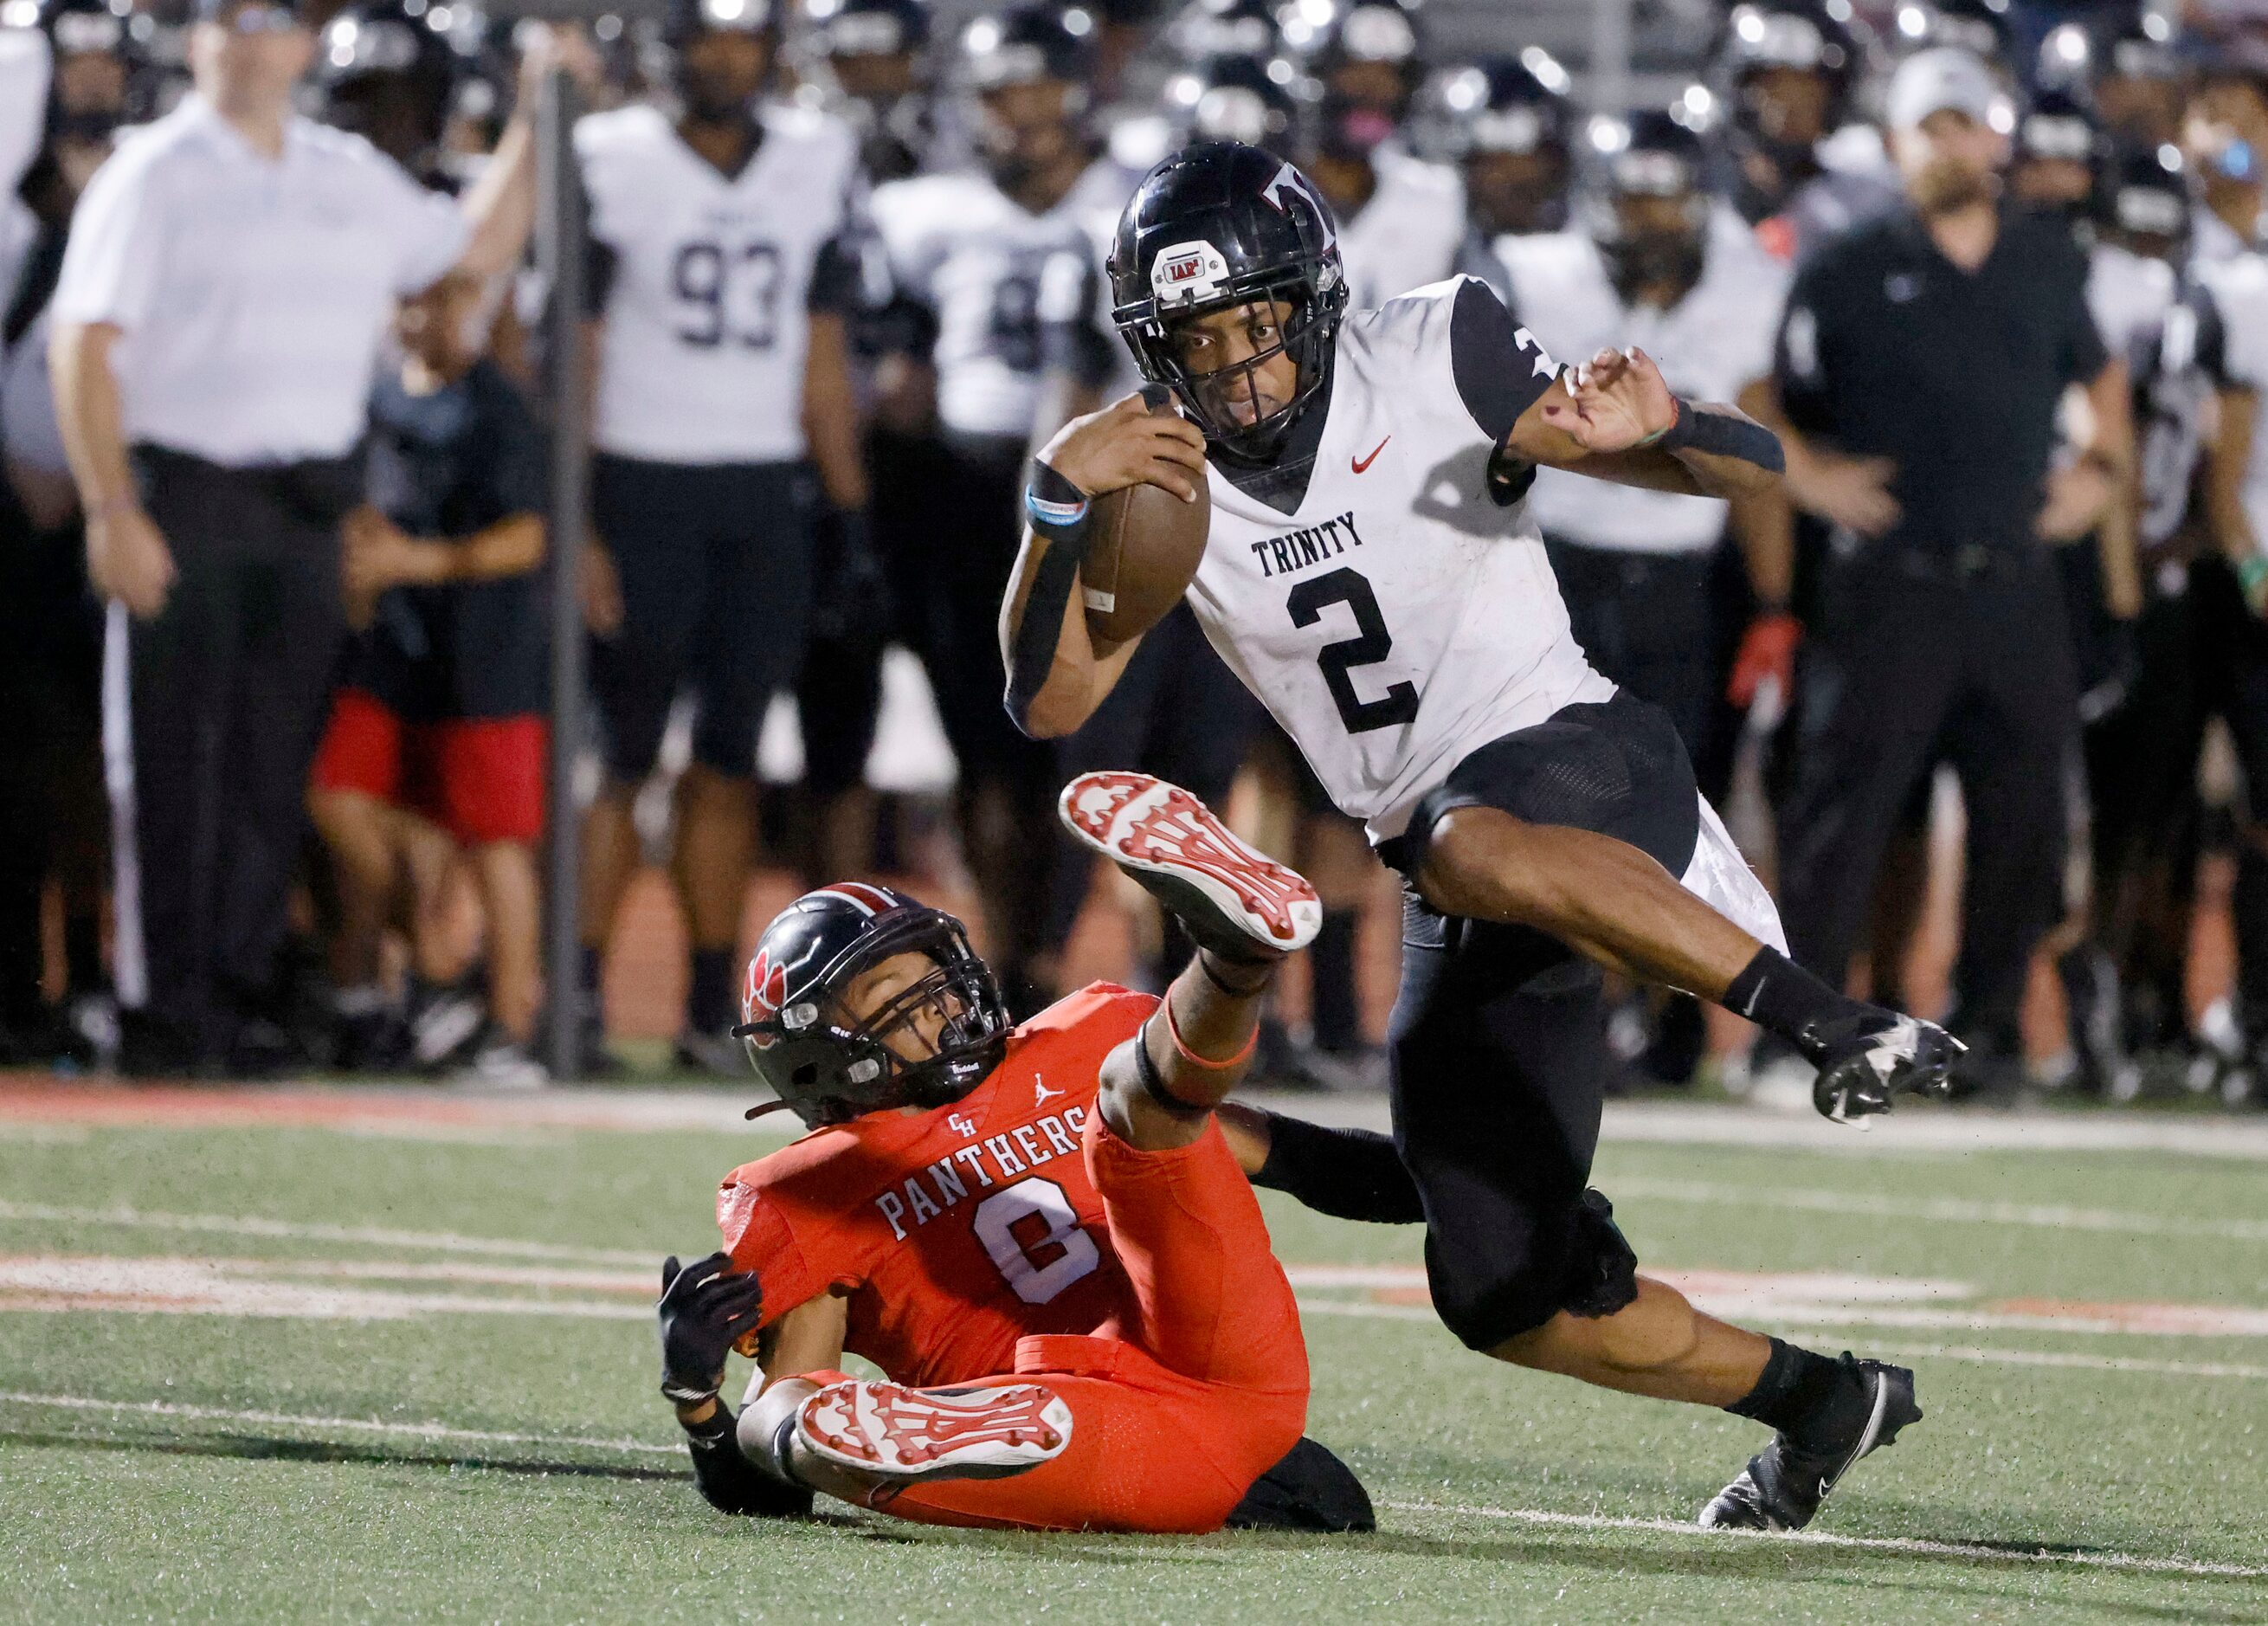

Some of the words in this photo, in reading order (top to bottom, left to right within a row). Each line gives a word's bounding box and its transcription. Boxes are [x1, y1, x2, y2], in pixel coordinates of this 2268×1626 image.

[673, 240, 782, 349] 93
[1251, 511, 1363, 577] TRINITY
[1286, 566, 1419, 734] 2
[875, 1106, 1086, 1242] PANTHERS
